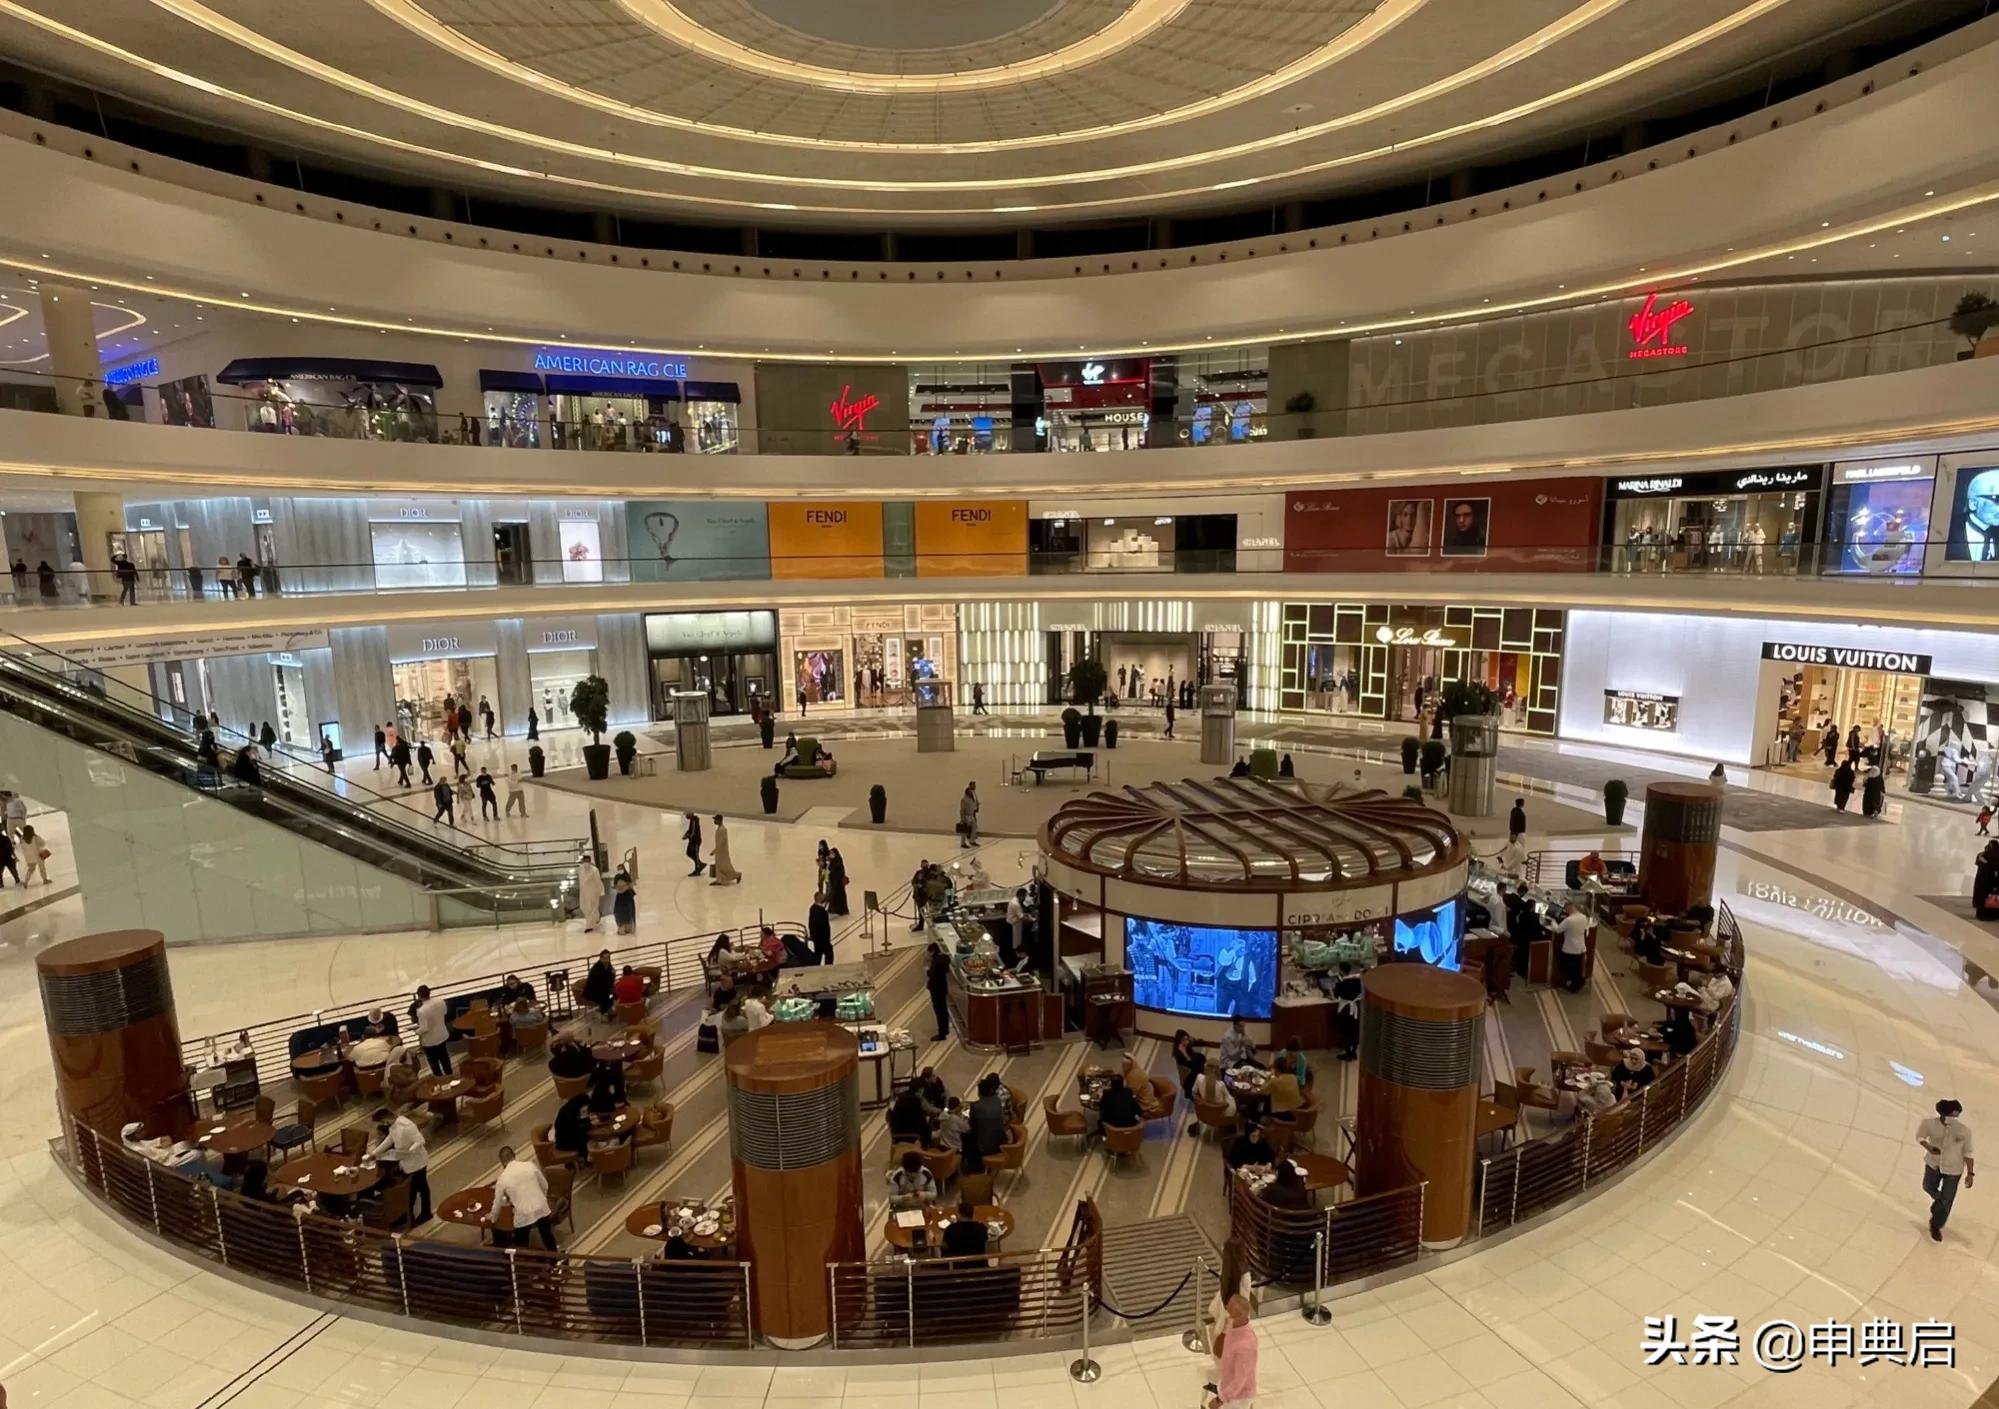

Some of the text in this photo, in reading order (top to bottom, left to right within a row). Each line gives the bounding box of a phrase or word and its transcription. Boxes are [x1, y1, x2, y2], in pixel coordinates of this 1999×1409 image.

[1629, 292, 1694, 345] Virgin
[1629, 346, 1688, 359] MEGASTORE
[535, 354, 688, 378] AMERICAN RAG CIE
[830, 384, 880, 430] Virgin
[1104, 411, 1144, 423] HOUSE
[1618, 478, 1683, 492] MARINA RINALDI
[400, 507, 428, 518] DIOR
[806, 510, 848, 523] FENDI
[952, 509, 992, 521] FENDI
[422, 637, 460, 651] DIOR
[543, 630, 577, 644] DIOR
[1773, 644, 1917, 672] LOUIS VUITTON
